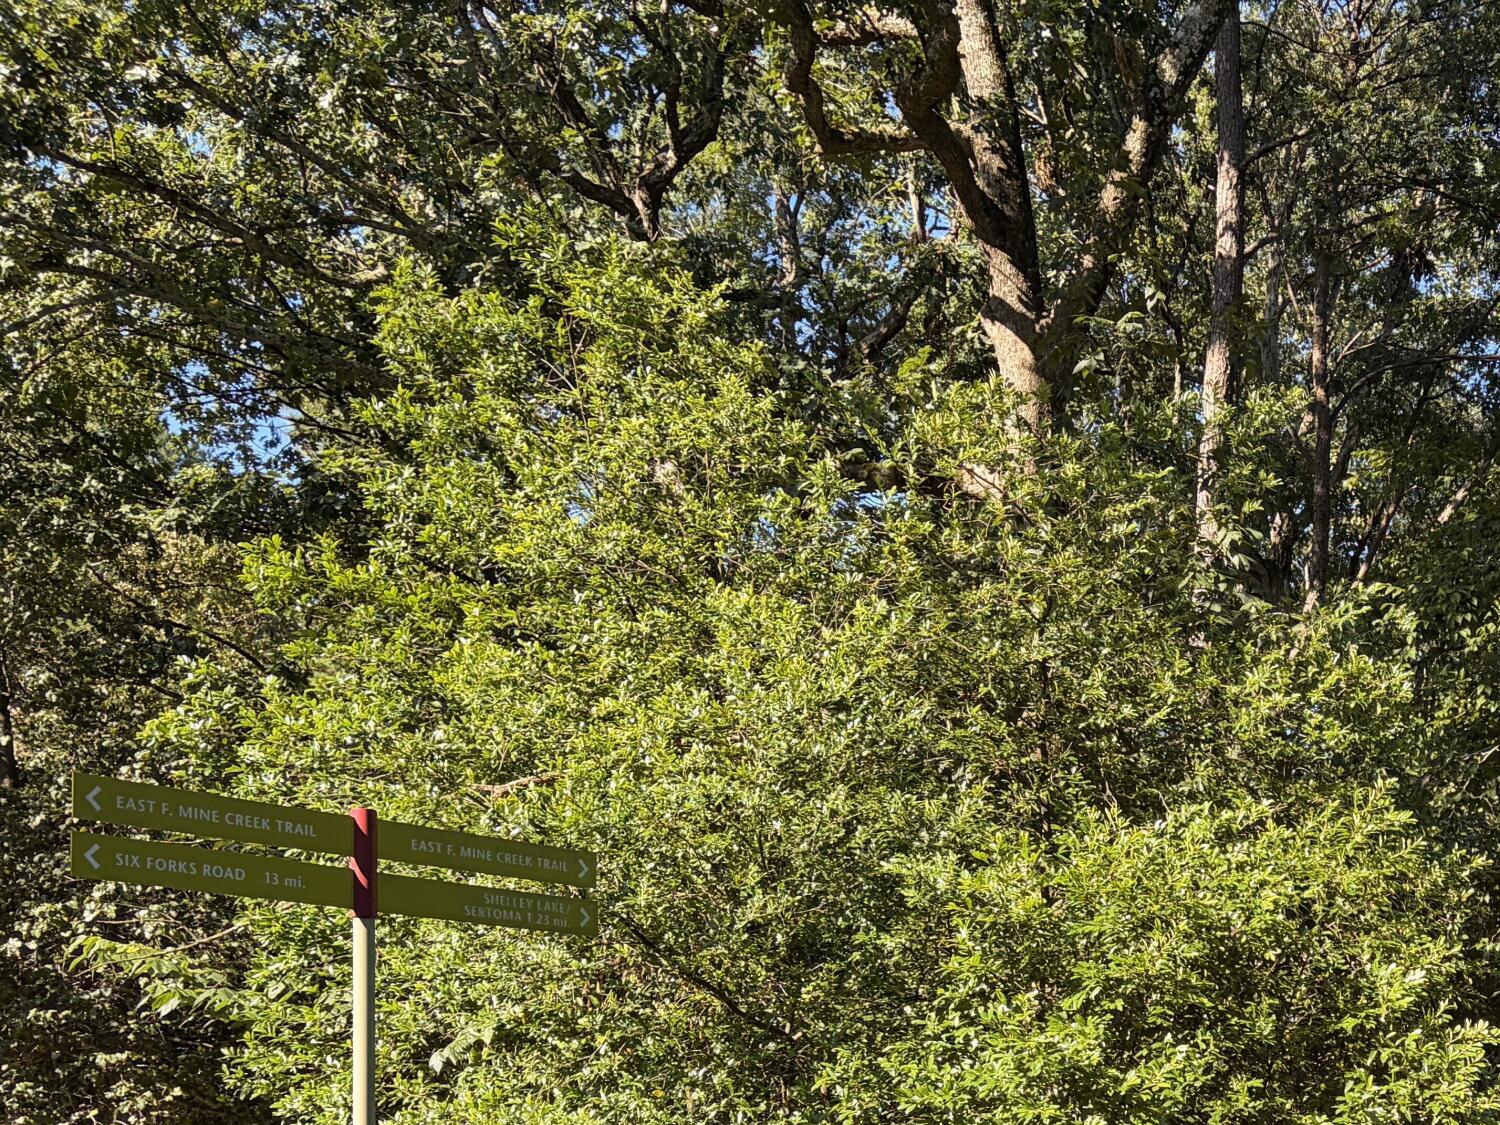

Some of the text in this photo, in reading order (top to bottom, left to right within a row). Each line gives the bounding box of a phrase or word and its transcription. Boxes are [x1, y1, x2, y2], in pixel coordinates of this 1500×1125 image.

[116, 796, 317, 837] EAST F. MINE CREEK TRAIL
[115, 853, 141, 867] SIX
[146, 858, 197, 875] FORKS
[202, 864, 246, 881] ROAD
[284, 877, 306, 889] mi.
[411, 839, 569, 872] EAST F. MINE CREEK TRAIL
[464, 905, 522, 922] SERTOMA
[527, 912, 550, 925] 123
[484, 893, 533, 909] SHELLEY
